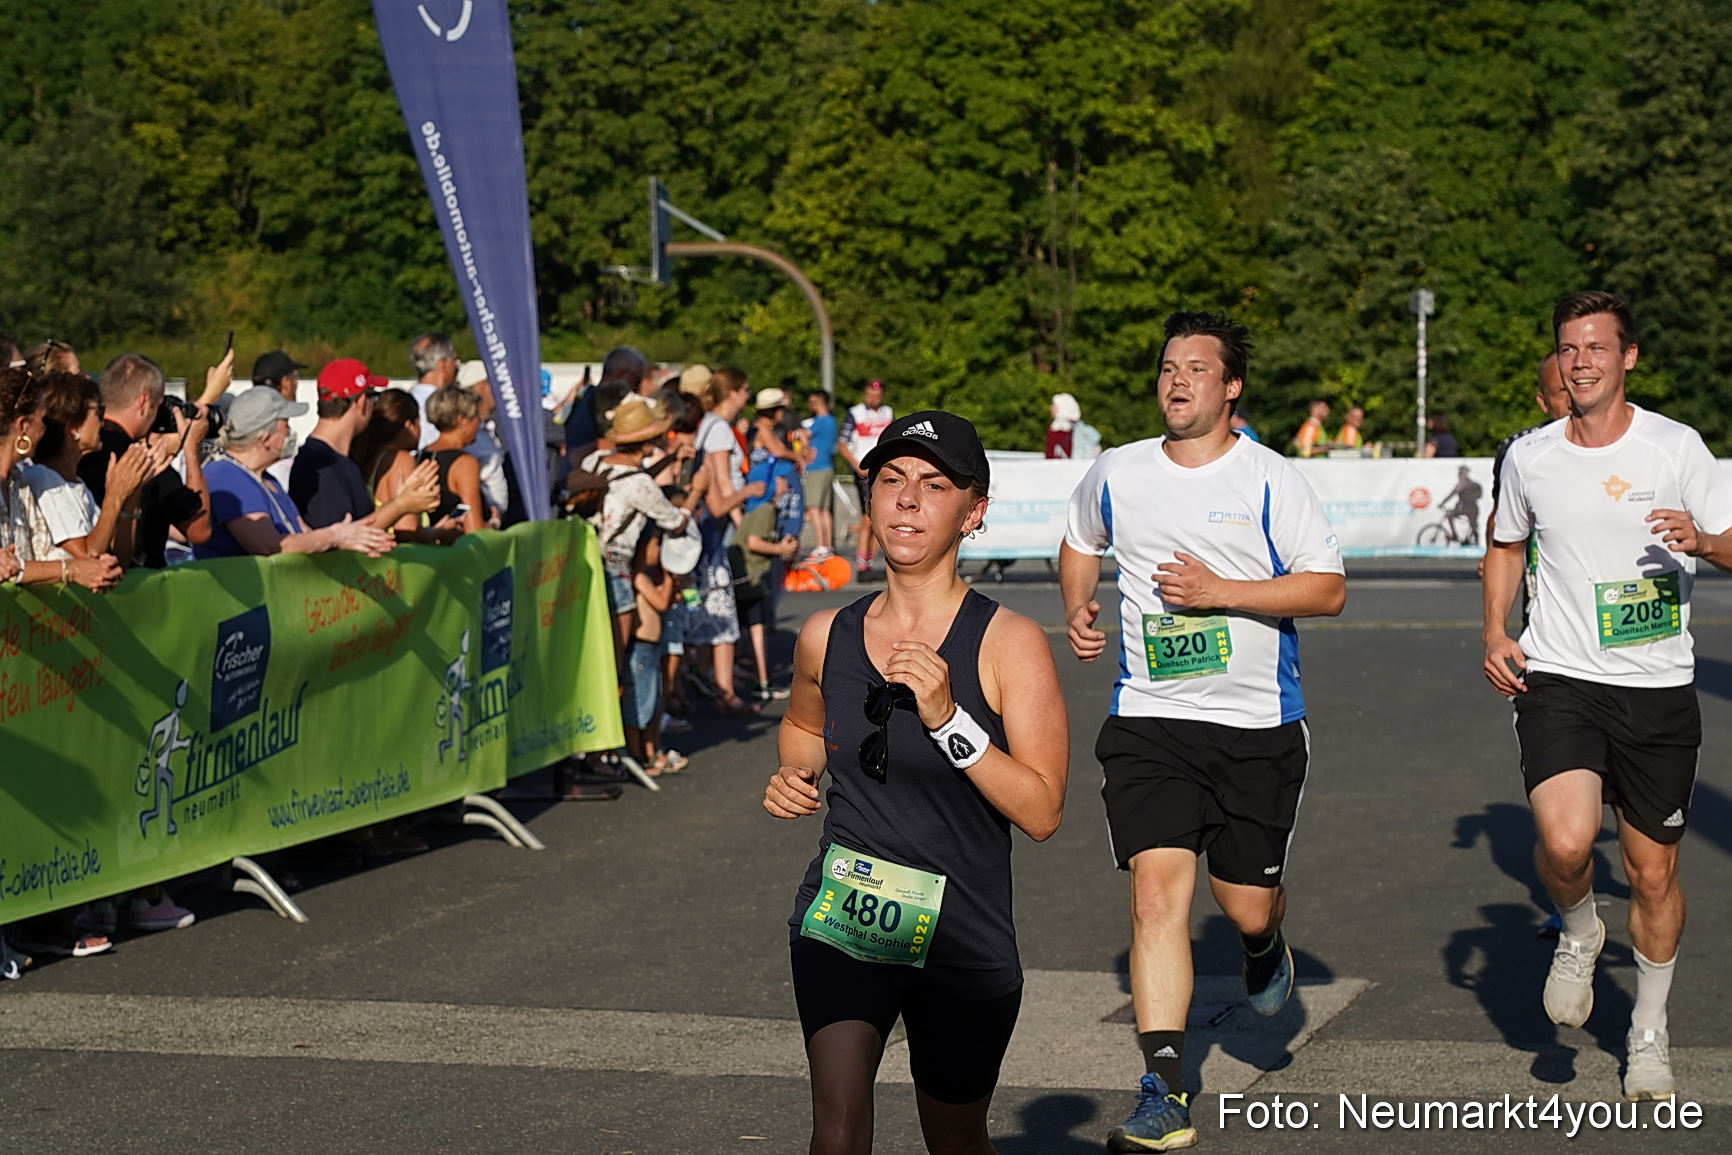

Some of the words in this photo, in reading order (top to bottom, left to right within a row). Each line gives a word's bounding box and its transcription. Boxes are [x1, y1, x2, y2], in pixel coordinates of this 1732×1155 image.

[902, 427, 938, 440] adidas
[1224, 512, 1251, 521] PETTER
[1602, 612, 1613, 637] RUN
[1621, 599, 1664, 625] 208
[28, 604, 92, 652] Firmen
[1612, 626, 1650, 636] Queitsch
[1651, 620, 1672, 631] Marco
[222, 644, 264, 673] Fischer
[1148, 644, 1158, 668] RUN
[1160, 632, 1207, 659] 320
[1216, 631, 1229, 663] 2022
[1157, 658, 1190, 669] Queitsch
[1191, 653, 1221, 665] Patrick
[36, 645, 103, 713] länger!
[184, 681, 308, 797] firmenlauf
[183, 781, 241, 825] neumarkt
[847, 870, 884, 886] Firmenlauf
[858, 881, 882, 891] neumarkt
[812, 888, 835, 922] RUN
[841, 888, 902, 933] 480
[823, 915, 867, 941] Westphal
[869, 931, 911, 949] Sophie
[909, 913, 931, 954] 2022
